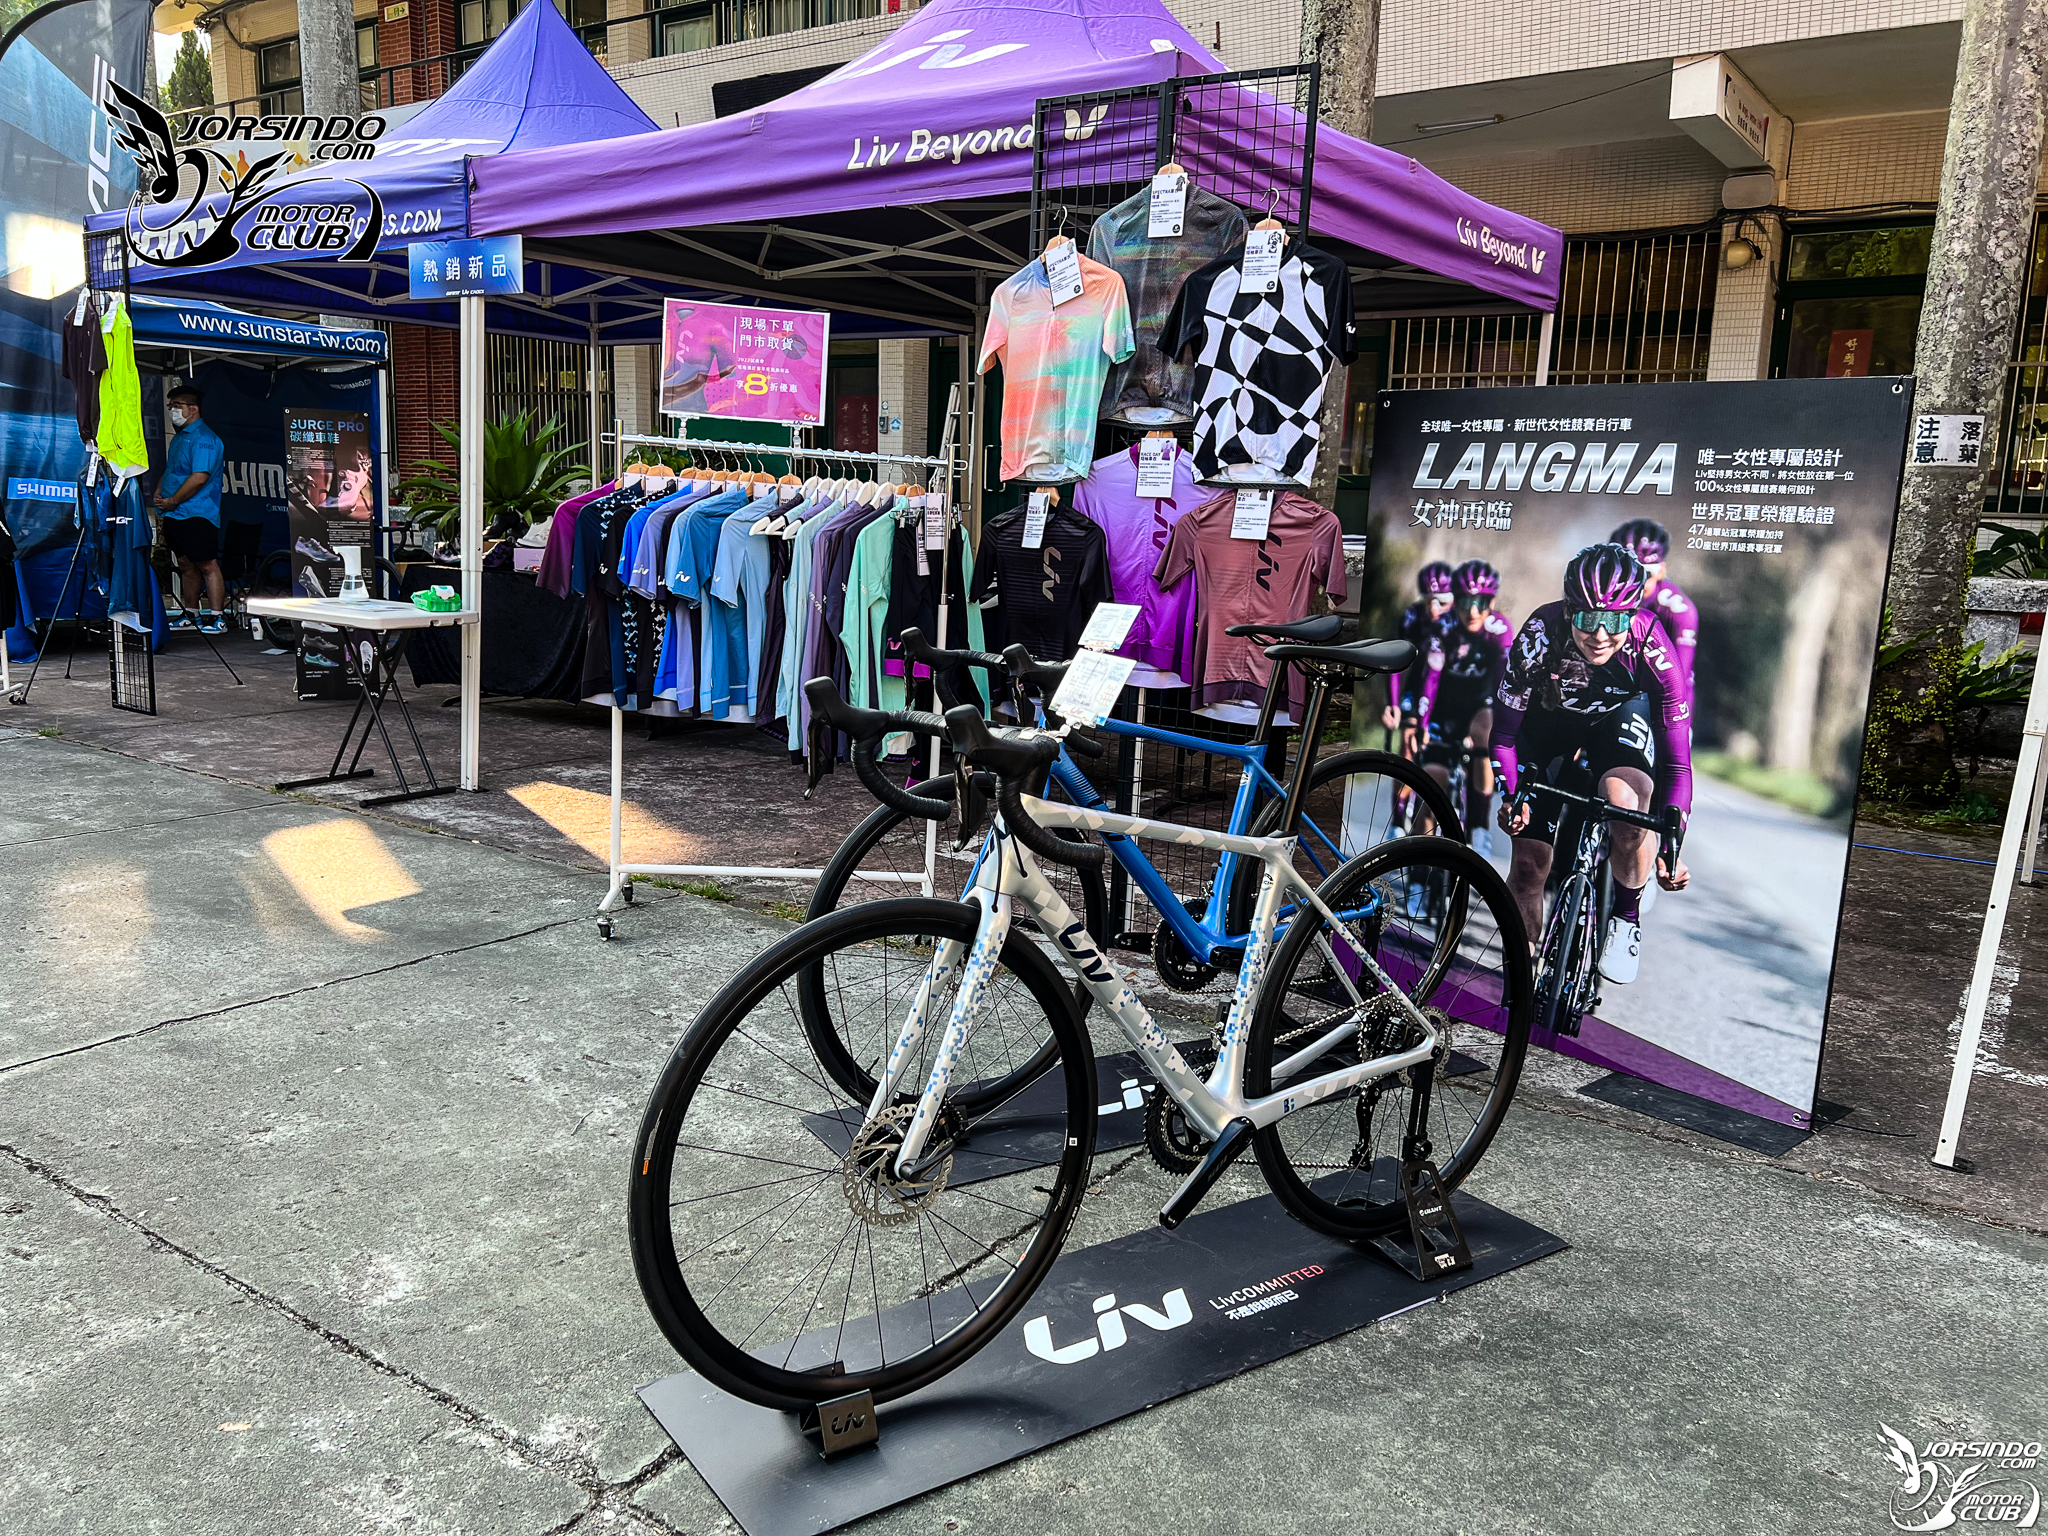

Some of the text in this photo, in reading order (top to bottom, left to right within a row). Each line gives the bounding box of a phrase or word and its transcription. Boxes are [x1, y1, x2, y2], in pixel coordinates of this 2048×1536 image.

[847, 136, 900, 170] Liv
[1456, 217, 1477, 249] Liv
[423, 254, 507, 282] 熱銷新品
[178, 312, 381, 354] www.sunstar-tw.com
[740, 316, 794, 333] 現場下單
[739, 334, 794, 351] 門市取貨
[290, 419, 365, 432] SURGE PRO
[290, 431, 340, 444] 碳纖車鞋
[1958, 421, 1982, 463] 落葉
[1411, 441, 1678, 495] LANGMA
[1697, 448, 1844, 467] 唯一女性專屬設計
[1410, 498, 1513, 531] 女神再臨
[1691, 503, 1835, 524] 世界冠軍榮耀驗證
[1042, 546, 1062, 602] Liv
[1255, 531, 1283, 592] Liv
[1618, 712, 1649, 750] Liv
[1058, 921, 1115, 982] Liv
[1208, 1264, 1324, 1310] LivCOMMITTED
[1023, 1287, 1194, 1365] Liv
[831, 1411, 866, 1435] Liv
